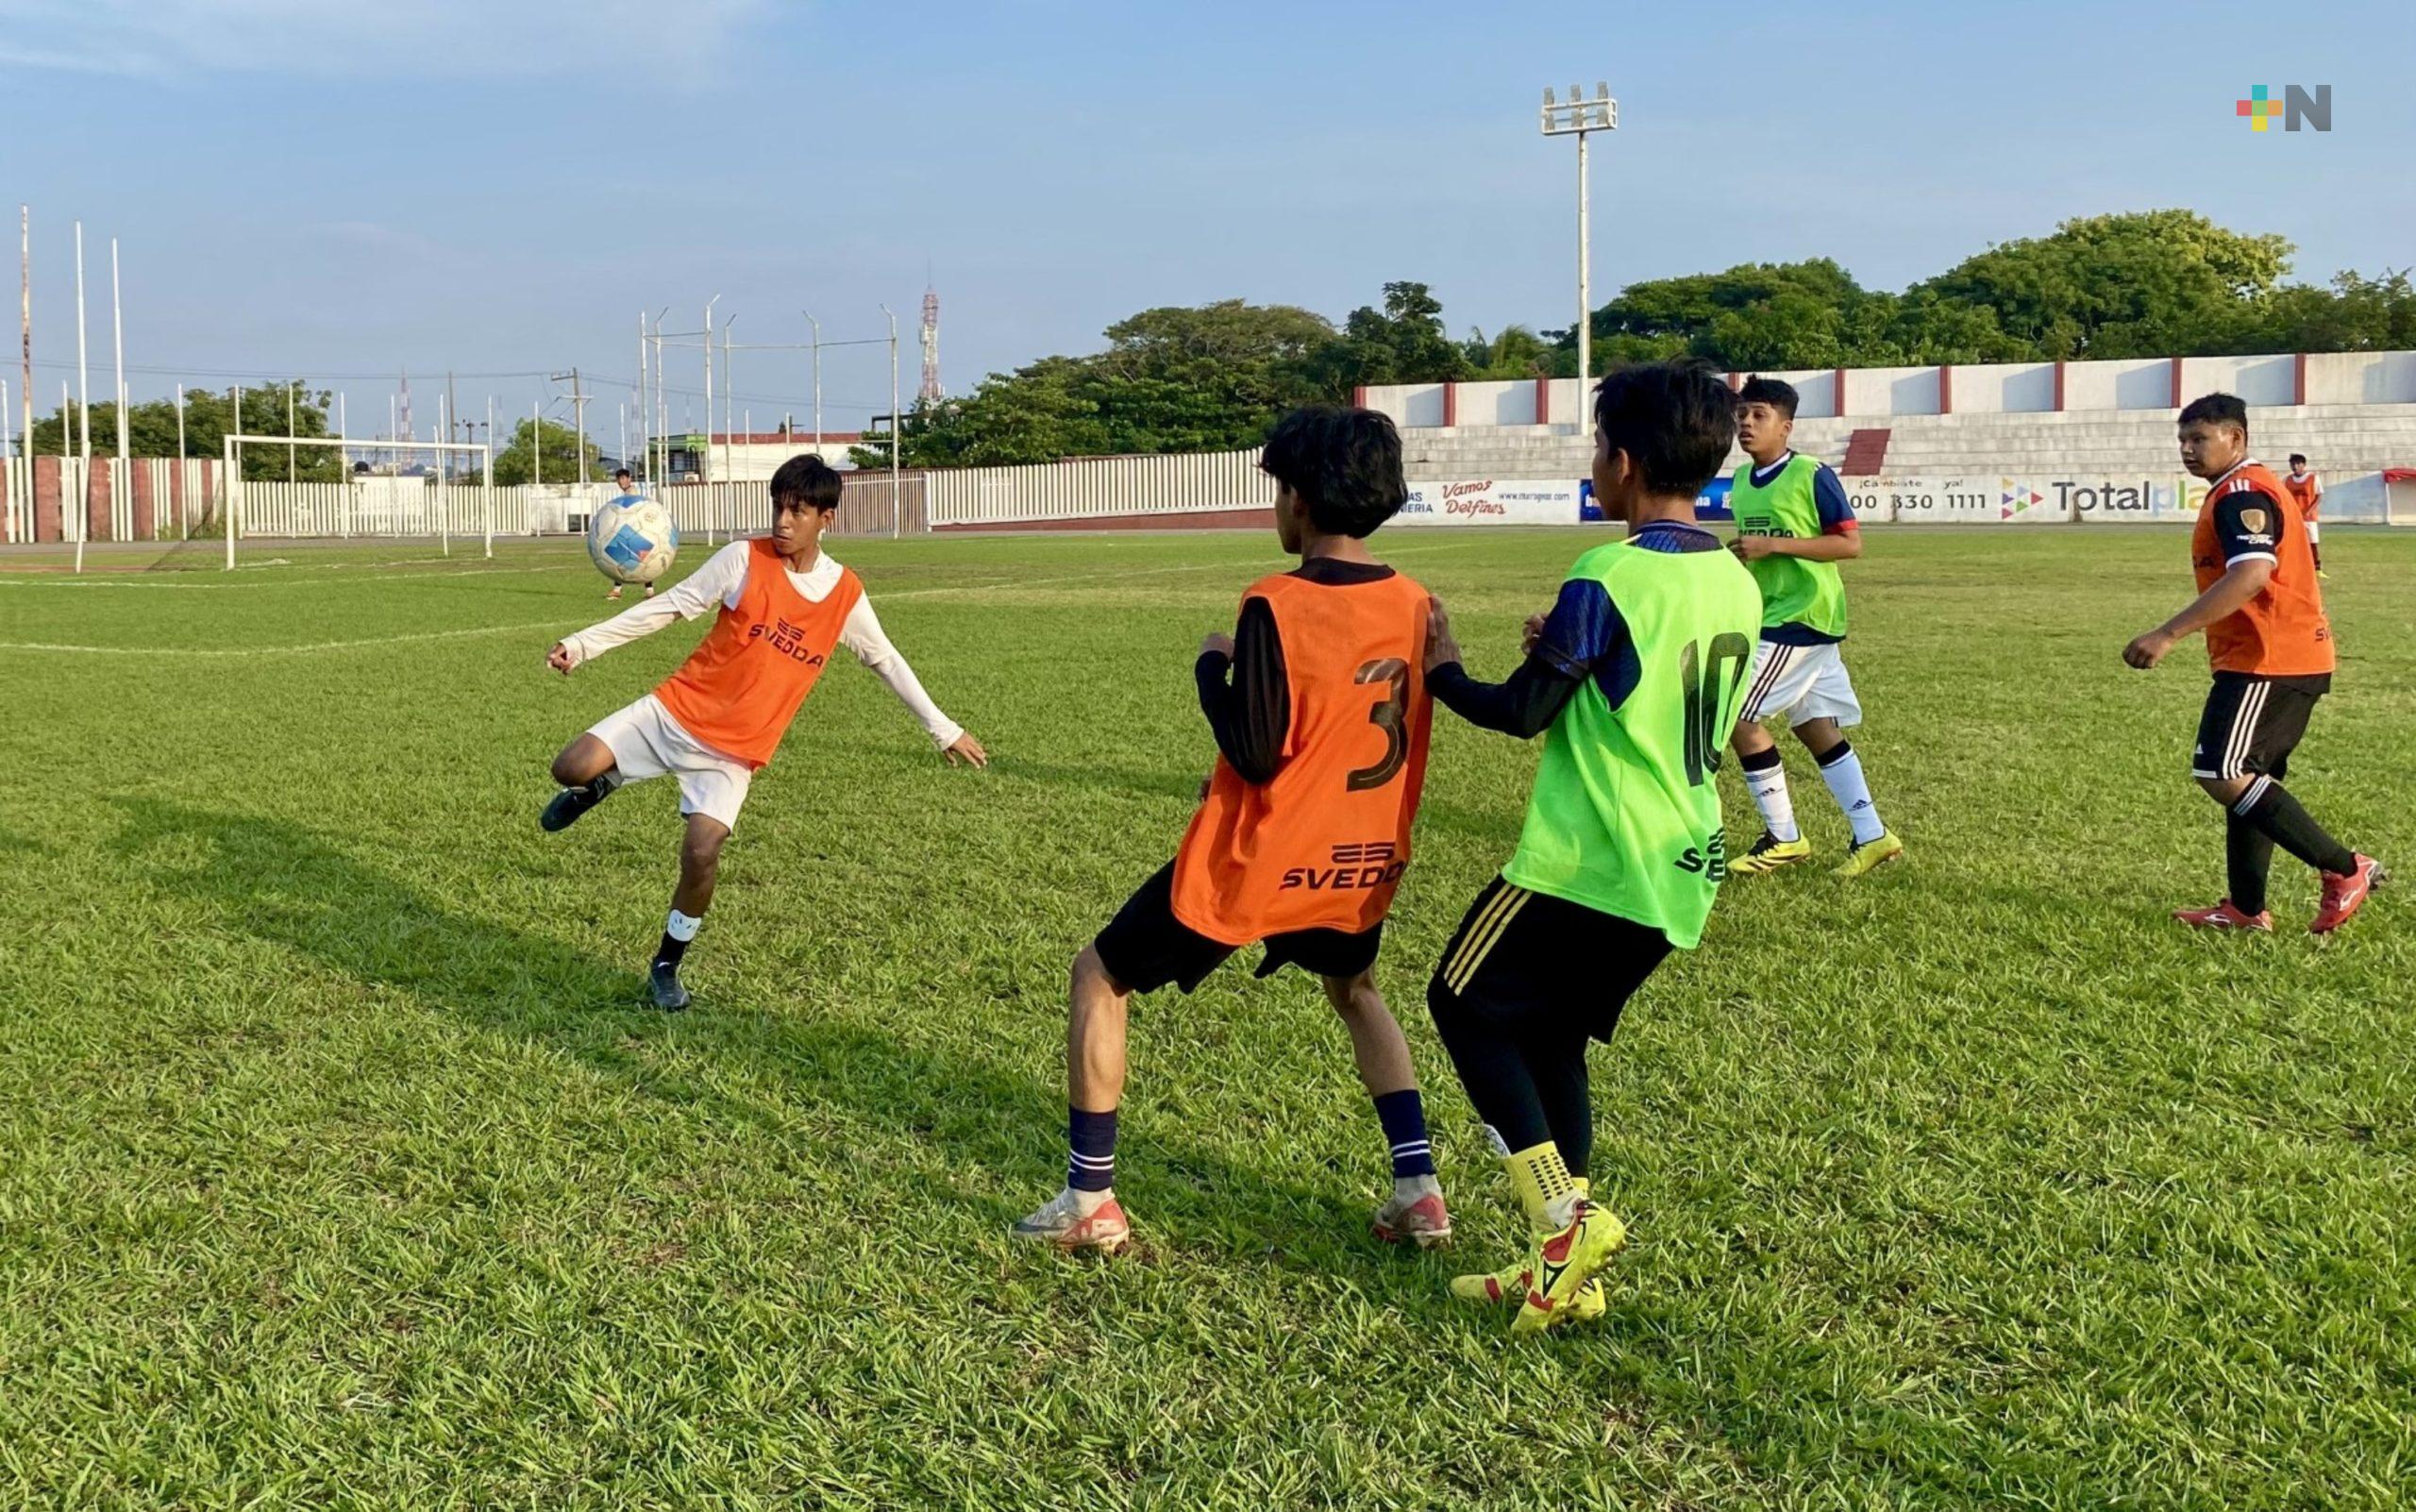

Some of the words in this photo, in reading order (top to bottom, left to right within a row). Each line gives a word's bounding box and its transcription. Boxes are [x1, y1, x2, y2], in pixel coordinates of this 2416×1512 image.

[1442, 480, 1493, 498] Vamos
[1944, 479, 1964, 490] ya!
[1445, 499, 1507, 518] Delfines
[1890, 494, 1934, 510] 330
[1947, 494, 1987, 510] 1111
[748, 624, 825, 668] SVEDDA
[1680, 631, 1751, 787] 10
[1346, 658, 1409, 792] 3
